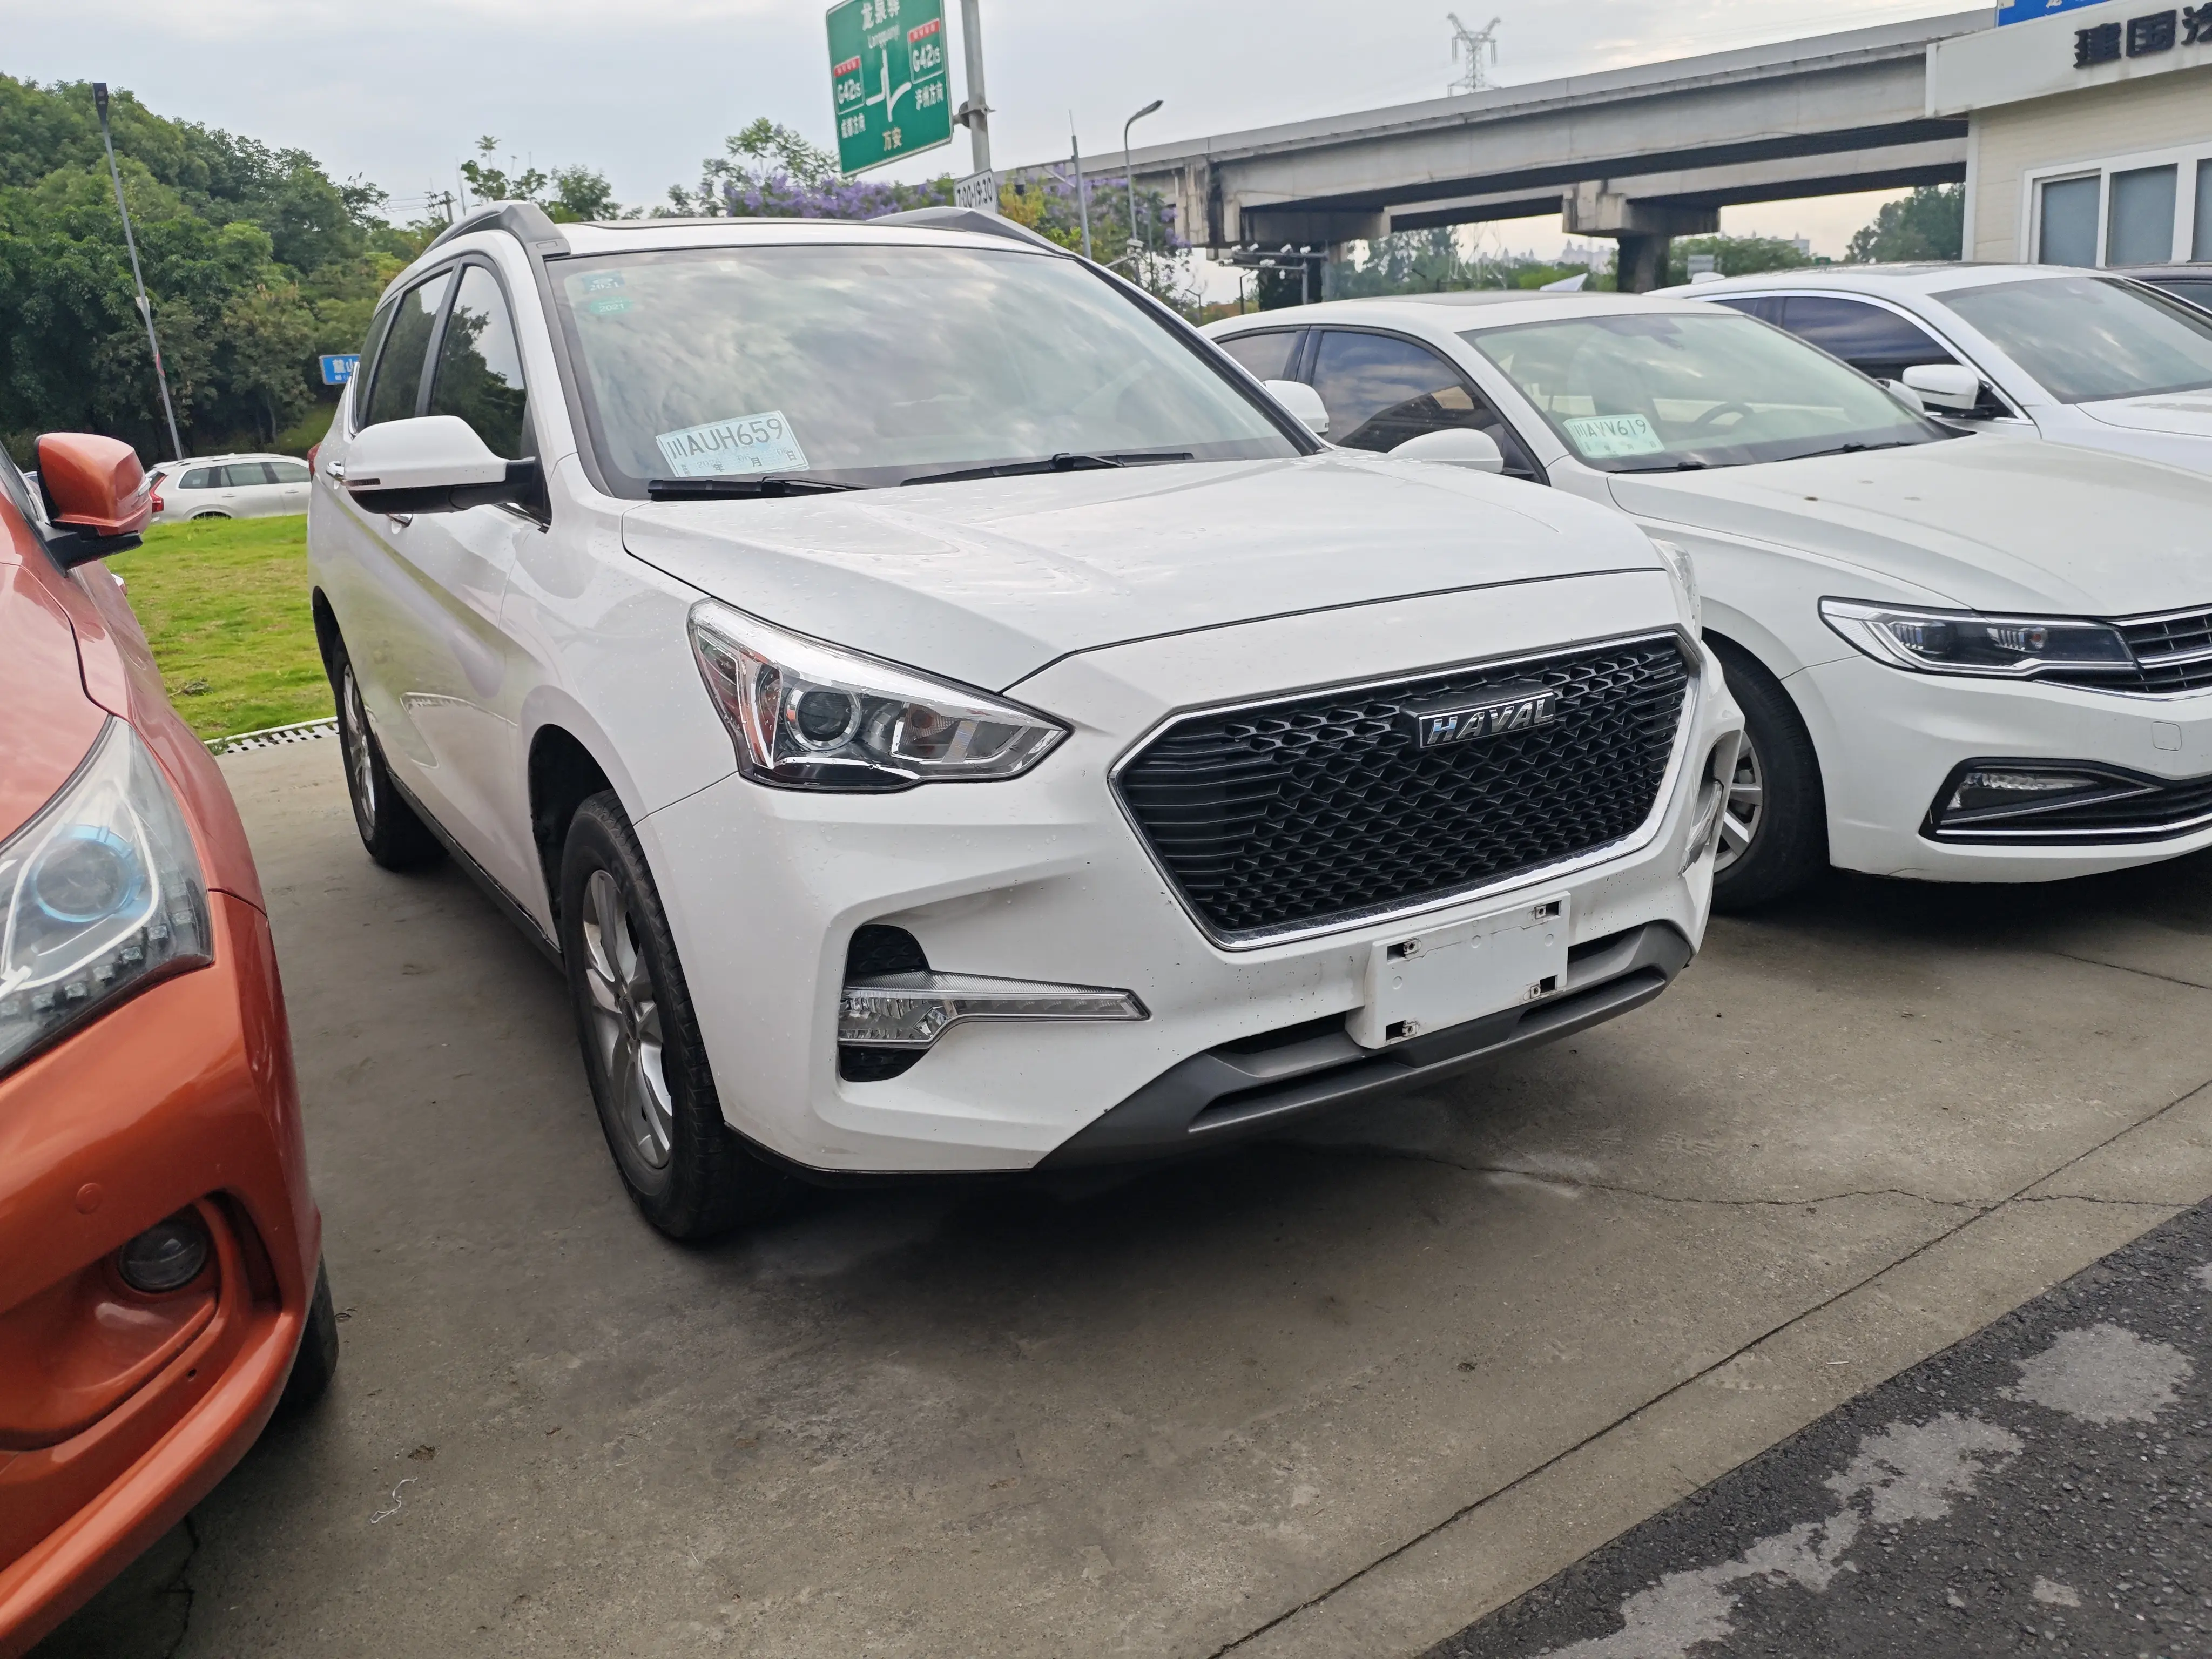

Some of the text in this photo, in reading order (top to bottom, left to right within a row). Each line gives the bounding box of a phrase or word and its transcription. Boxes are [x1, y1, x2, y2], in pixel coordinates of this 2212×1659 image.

[599, 303, 624, 312] 2021
[667, 417, 783, 460] 川AUH659
[1427, 699, 1554, 744] HAVAL
